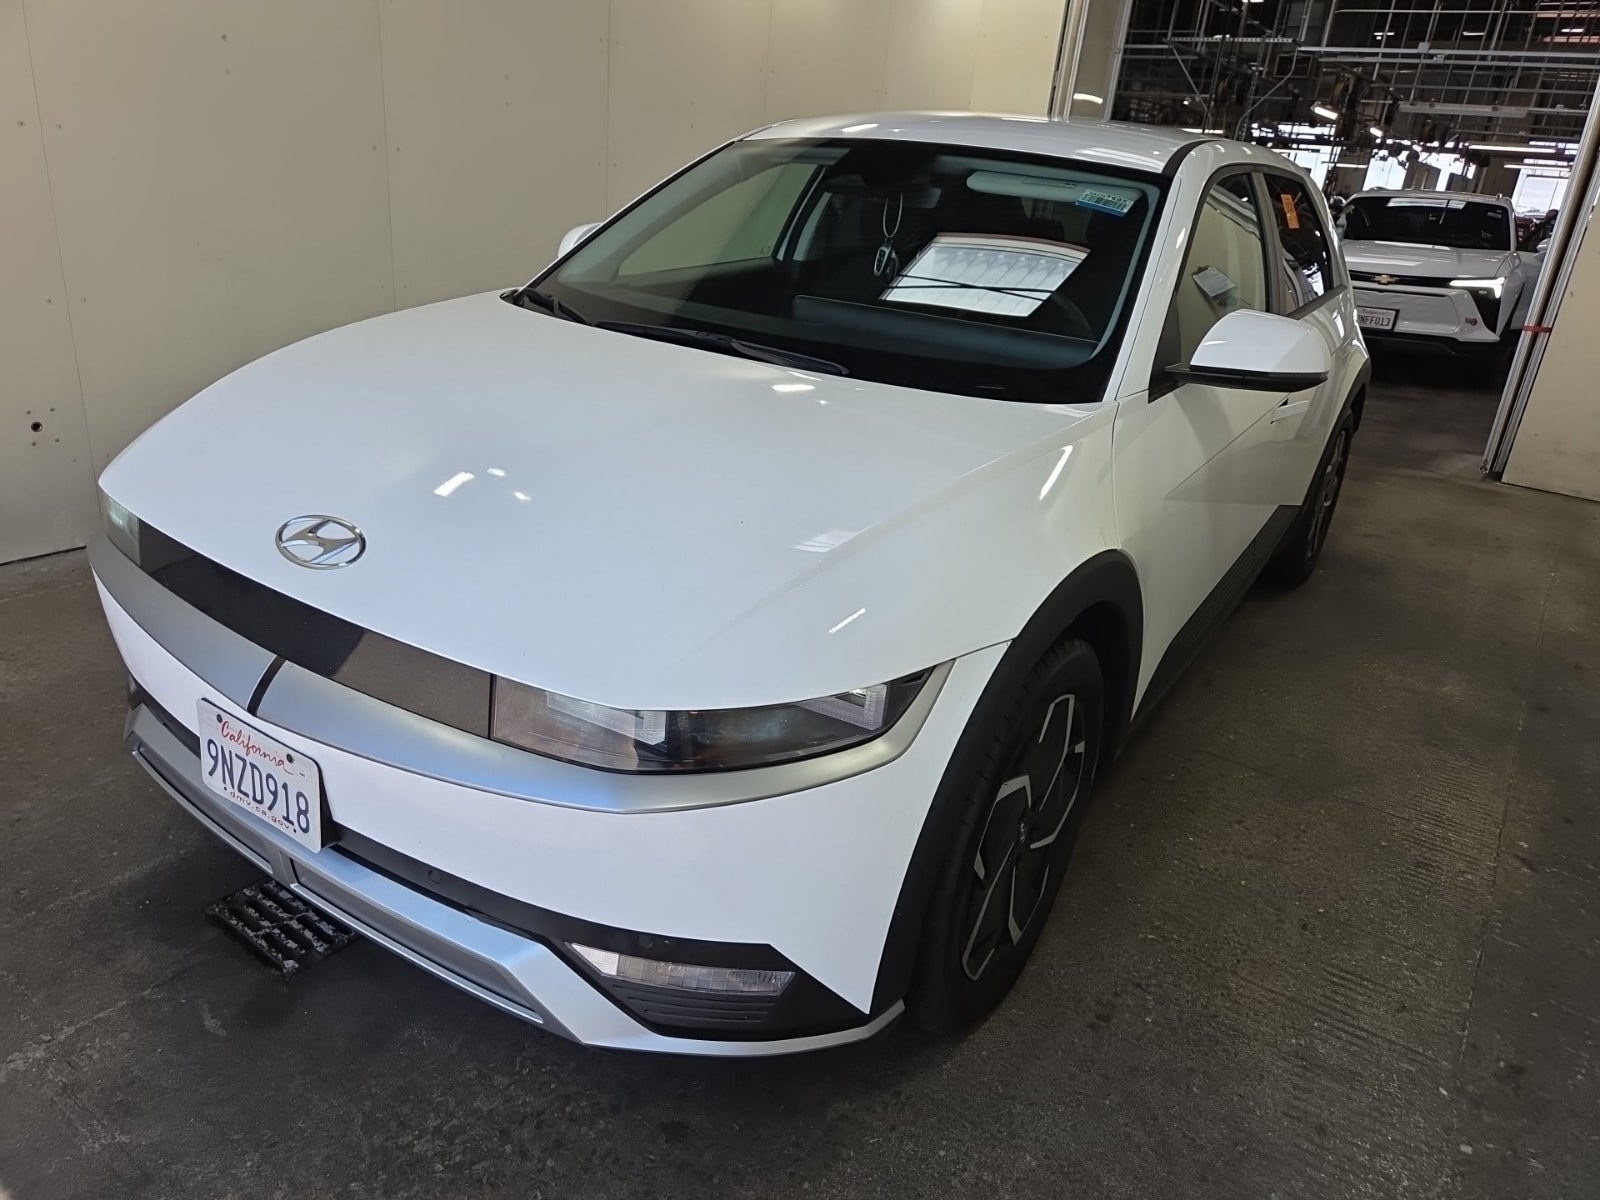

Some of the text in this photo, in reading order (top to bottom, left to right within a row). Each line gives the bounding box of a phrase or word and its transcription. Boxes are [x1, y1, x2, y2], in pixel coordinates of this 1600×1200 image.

[221, 720, 294, 775] California
[207, 738, 310, 834] 9NZD918
[230, 790, 290, 830] dmv.ca.gov
